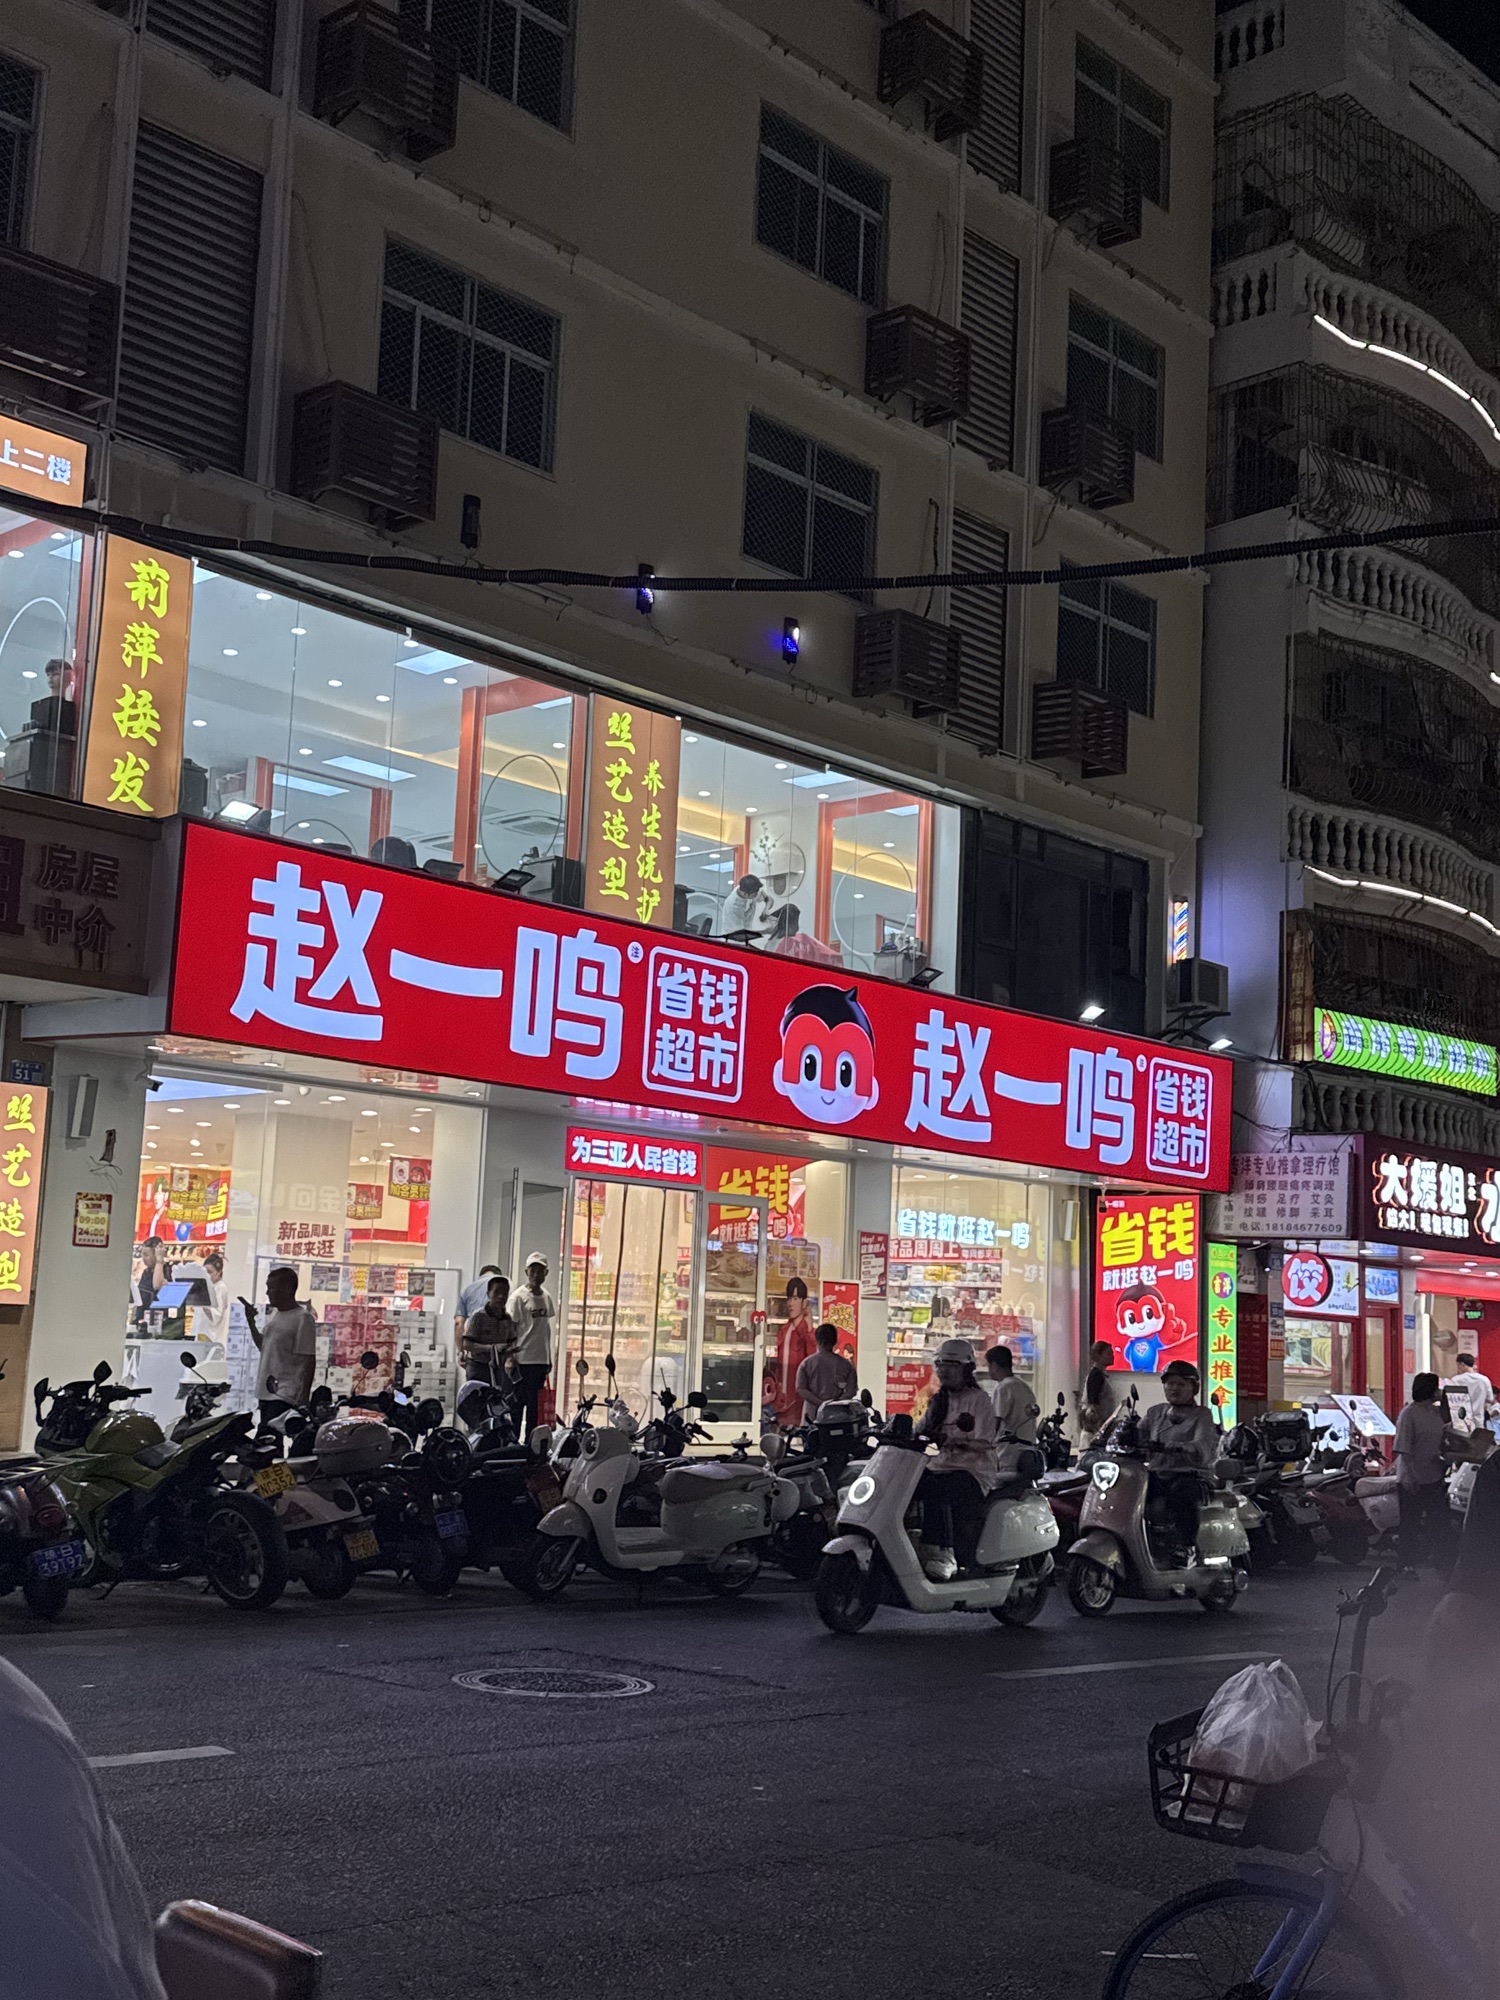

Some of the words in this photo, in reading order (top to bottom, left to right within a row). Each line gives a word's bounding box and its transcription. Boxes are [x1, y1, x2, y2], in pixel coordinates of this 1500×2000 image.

[108, 558, 170, 812] 莉萍接发
[599, 712, 636, 901] 丝艺造型
[636, 759, 666, 924] 养生洗护
[36, 843, 120, 900] 房屋
[37, 899, 116, 956] 中介
[230, 860, 624, 1081] 赵一鸣
[656, 962, 739, 1029] 省钱
[15, 1068, 30, 1081] 51
[651, 1023, 738, 1088] 超市
[904, 1009, 1135, 1165] 赵一鸣
[1154, 1069, 1206, 1120] 省钱
[571, 1135, 698, 1177] 为三亚人民省钱
[1151, 1117, 1206, 1168] 超市
[718, 1164, 790, 1221] 省钱
[78, 1228, 105, 1237] 24:00
[79, 1216, 106, 1226] 09:00
[278, 1221, 337, 1241] 新品周周上
[897, 1208, 1031, 1250] 省钱就逛赵一鸣
[1101, 1201, 1195, 1267] 省钱
[1102, 1259, 1195, 1292] 就逛赵一鸣
[1288, 1258, 1323, 1301] 饺
[259, 1474, 295, 1497] NC352
